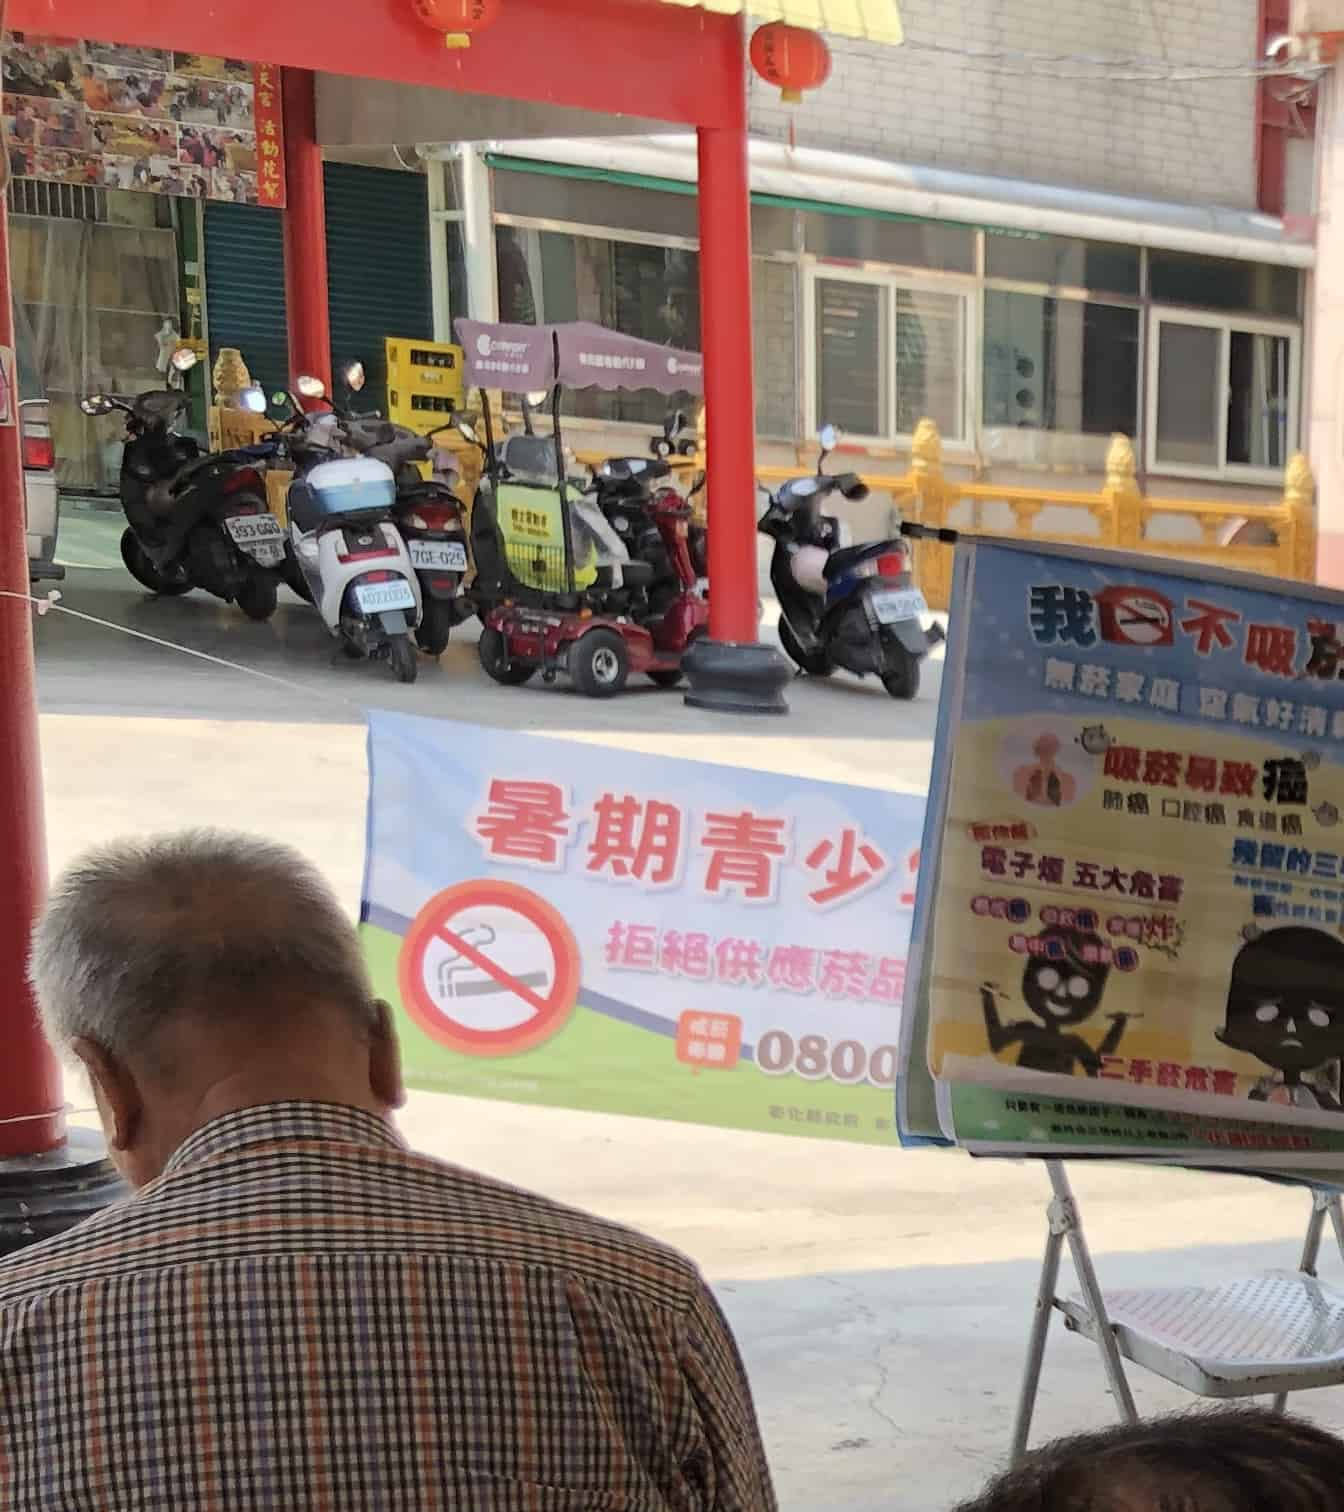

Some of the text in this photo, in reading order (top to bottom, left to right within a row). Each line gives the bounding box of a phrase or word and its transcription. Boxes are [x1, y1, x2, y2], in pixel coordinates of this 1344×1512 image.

[1029, 585, 1097, 648] 我
[1044, 657, 1182, 712] 無菸家庭
[1072, 860, 1185, 902] 五大危害
[604, 919, 907, 1001] 拒絕供應菸品
